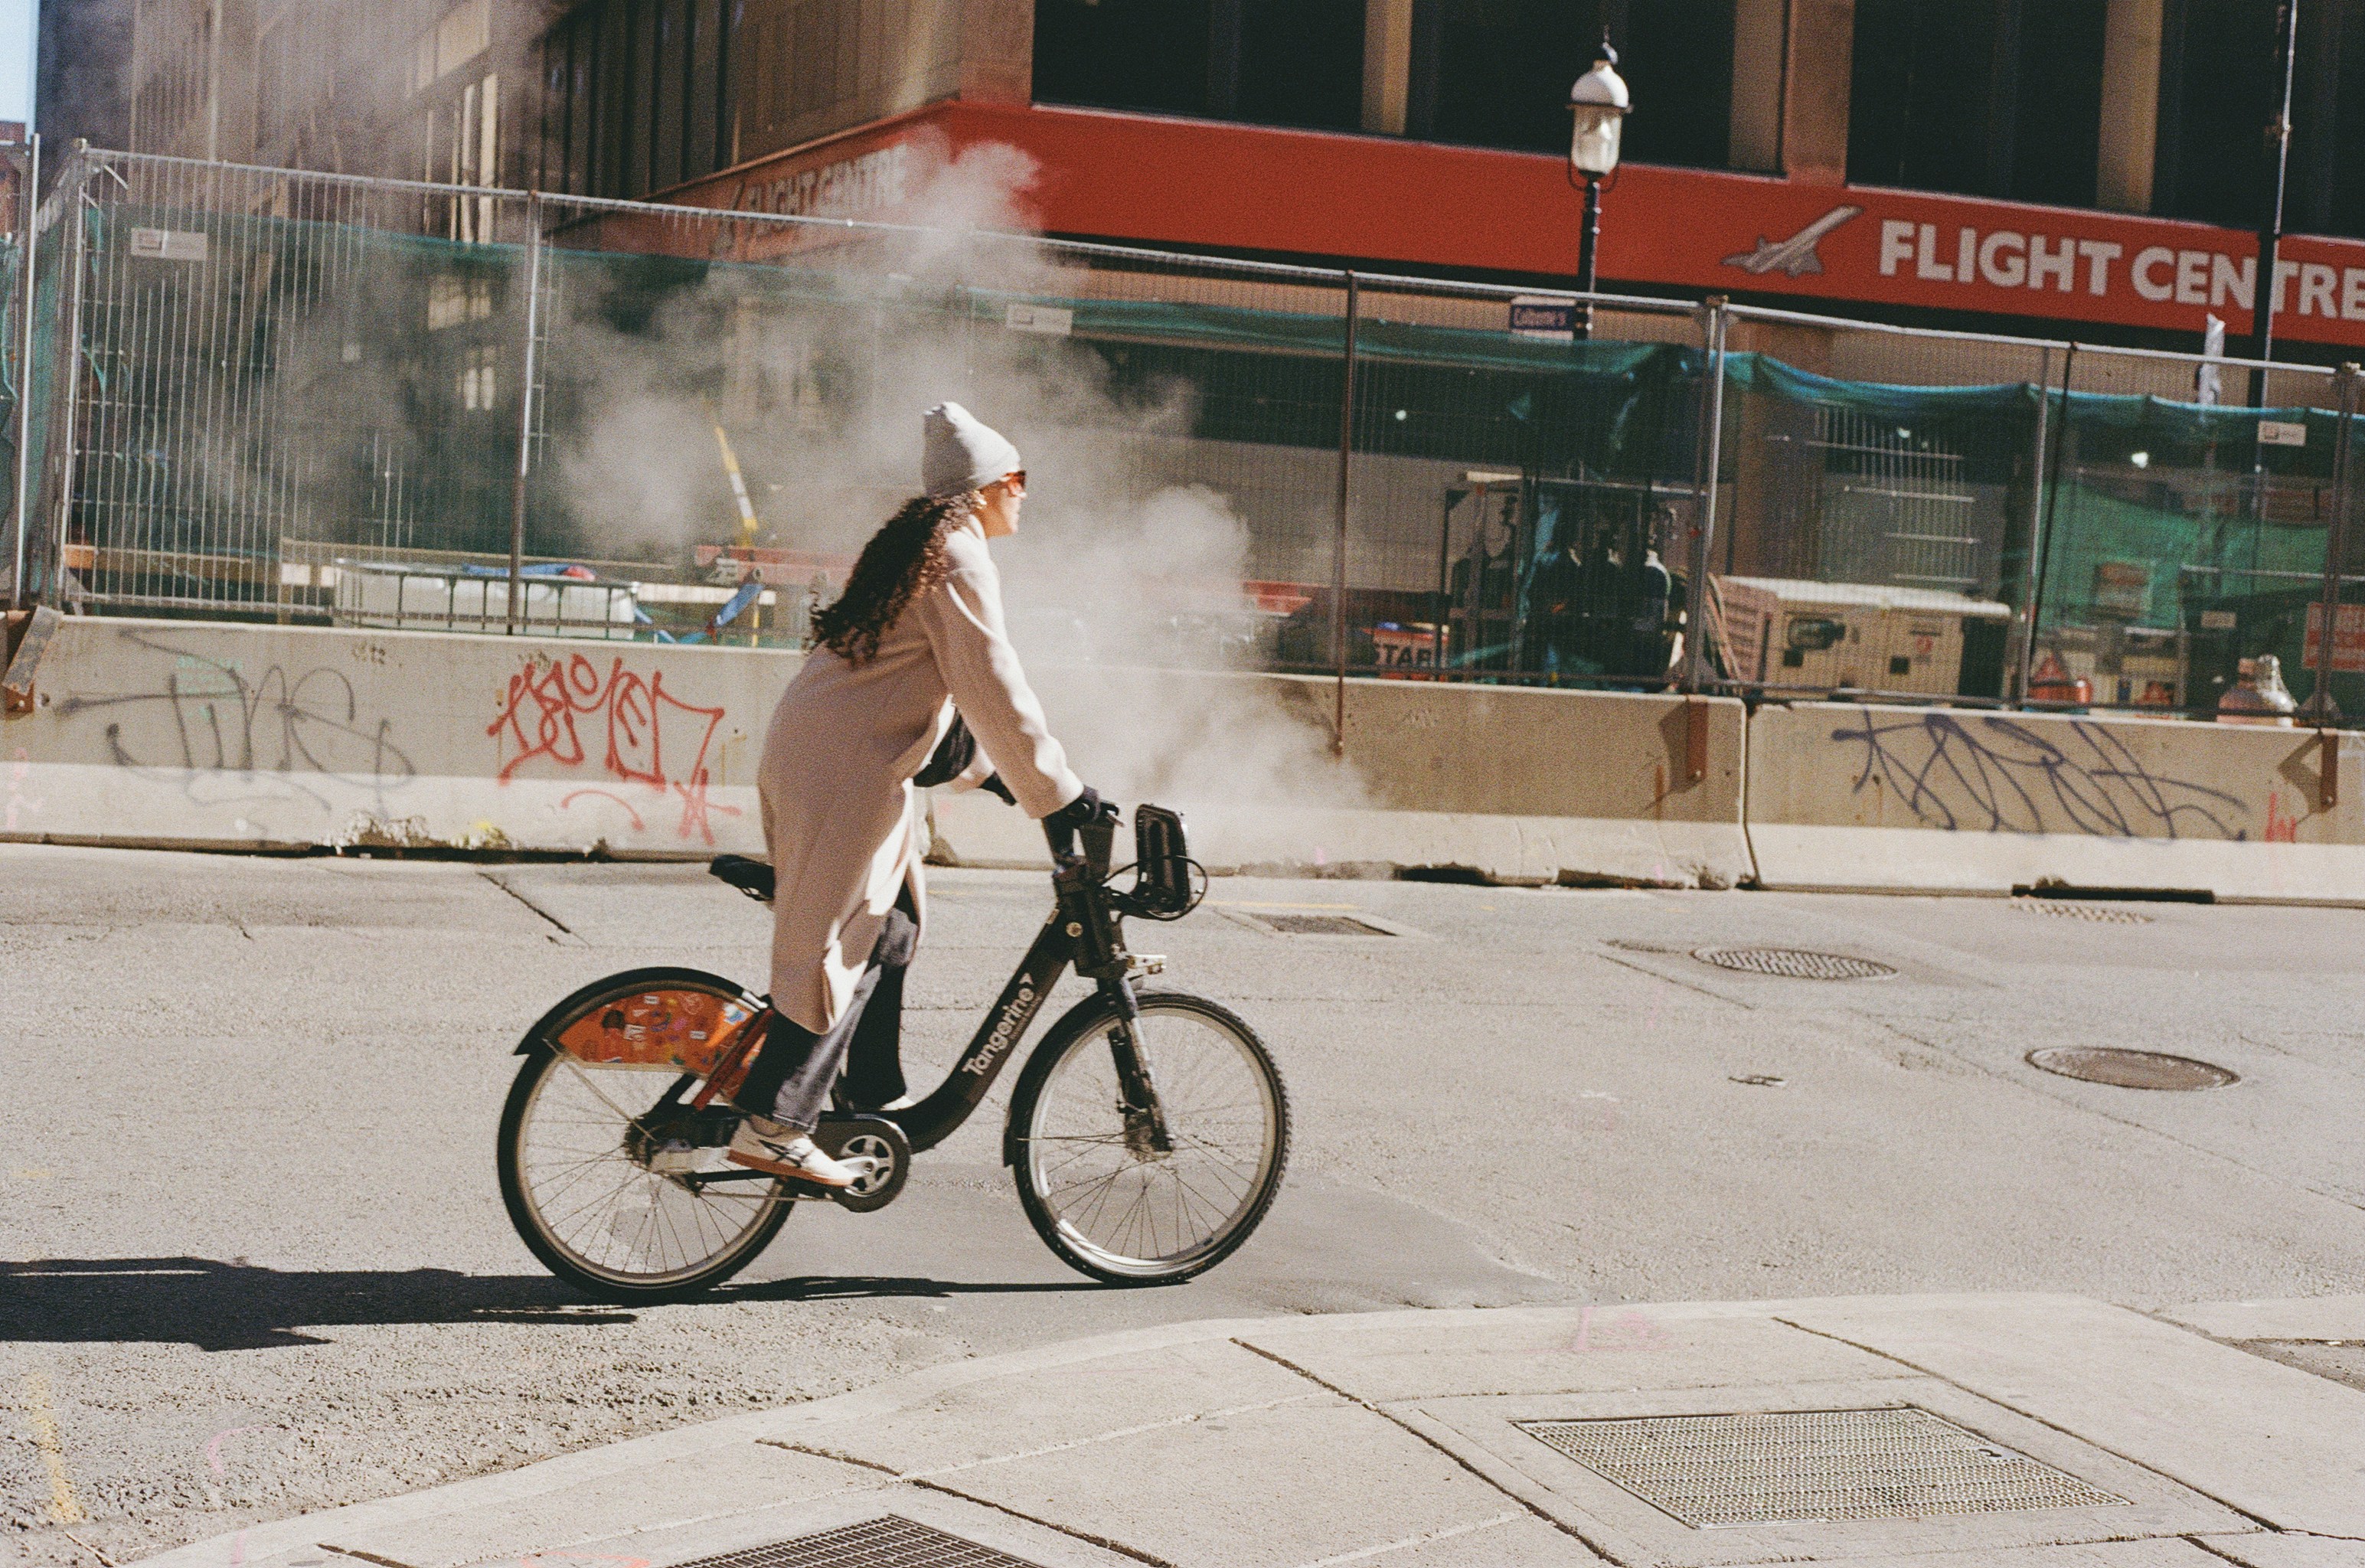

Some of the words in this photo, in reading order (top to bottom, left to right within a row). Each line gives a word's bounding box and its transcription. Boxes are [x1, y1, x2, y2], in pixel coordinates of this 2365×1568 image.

[1879, 220, 2123, 296] FLIGHT
[2131, 246, 2365, 322] CENTRE
[962, 987, 1034, 1075] Tangerine
